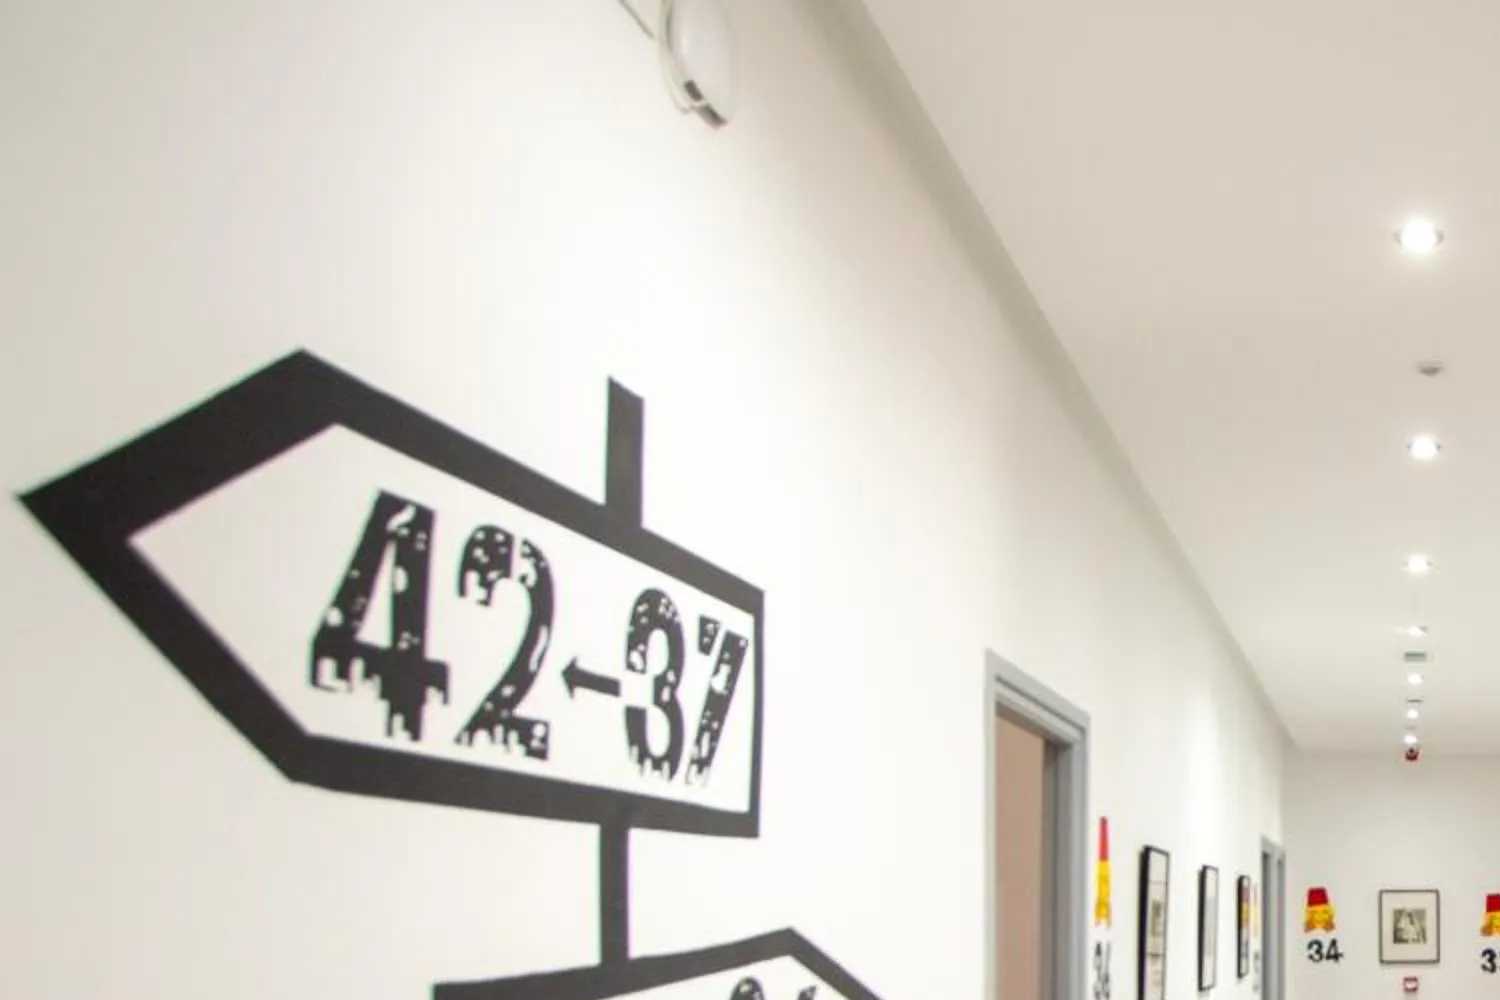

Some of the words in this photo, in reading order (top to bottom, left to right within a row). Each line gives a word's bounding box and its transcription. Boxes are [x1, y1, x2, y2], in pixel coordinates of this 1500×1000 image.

[309, 490, 554, 760] 42
[624, 587, 750, 787] 37
[1307, 938, 1344, 963] 34
